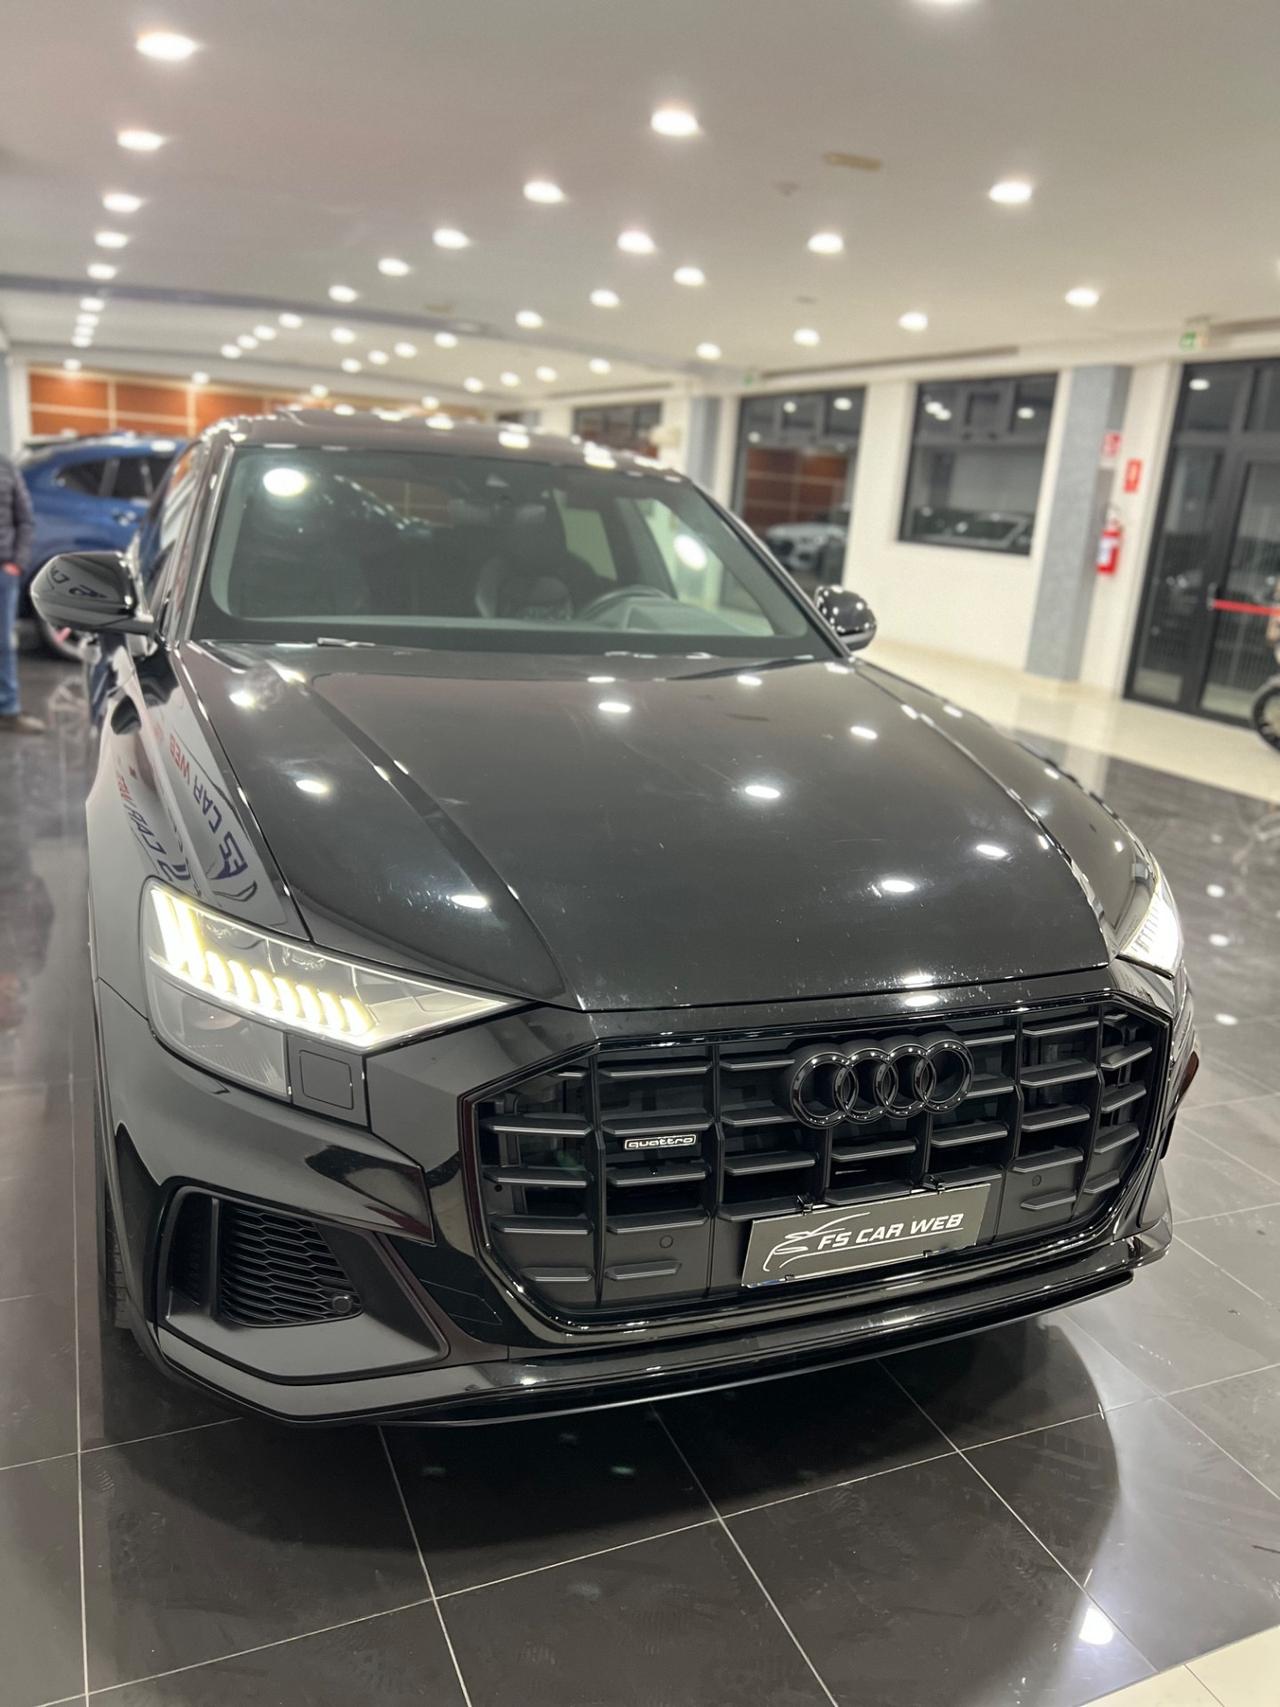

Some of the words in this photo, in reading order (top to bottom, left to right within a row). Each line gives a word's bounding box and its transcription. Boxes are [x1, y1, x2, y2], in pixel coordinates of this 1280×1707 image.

[193, 776, 222, 834] CAR
[628, 1137, 693, 1149] quattro
[817, 1232, 852, 1250] FS
[855, 1223, 904, 1245] CAR
[910, 1213, 964, 1234] WEB
